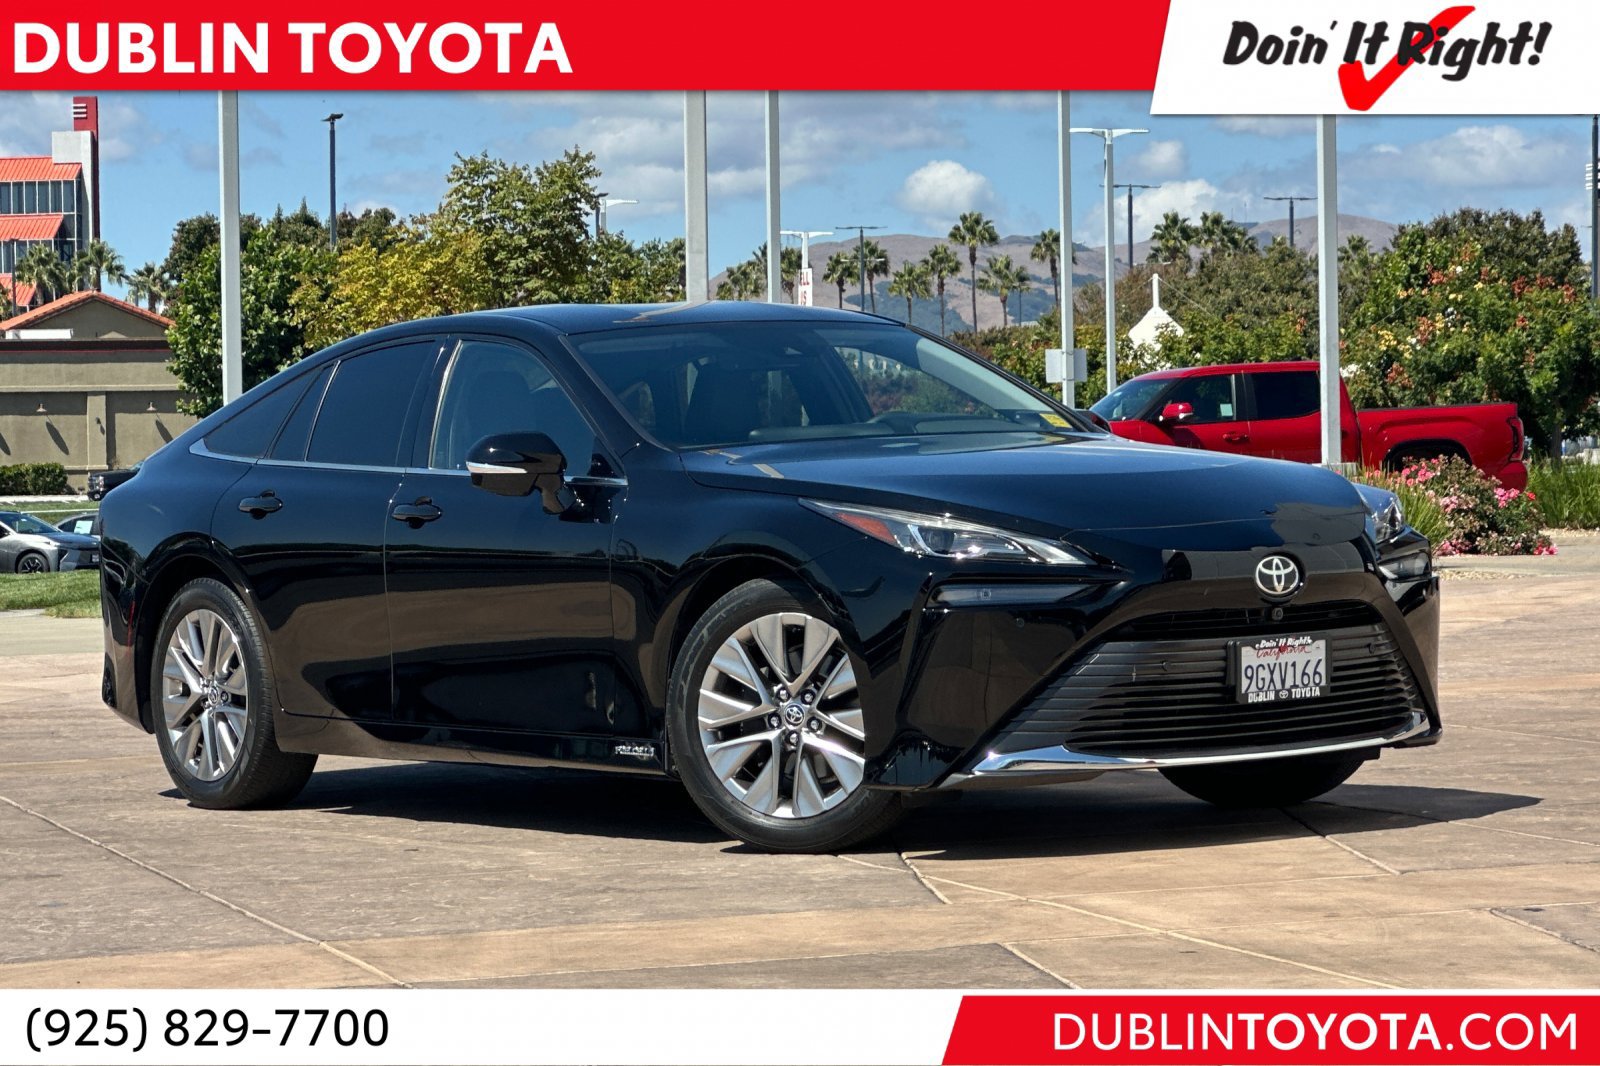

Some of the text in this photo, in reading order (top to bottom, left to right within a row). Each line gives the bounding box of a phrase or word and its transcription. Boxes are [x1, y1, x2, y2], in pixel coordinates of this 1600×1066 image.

[1244, 659, 1323, 693] 9GXV166
[1248, 687, 1320, 703] DUBLIN TOYOTA
